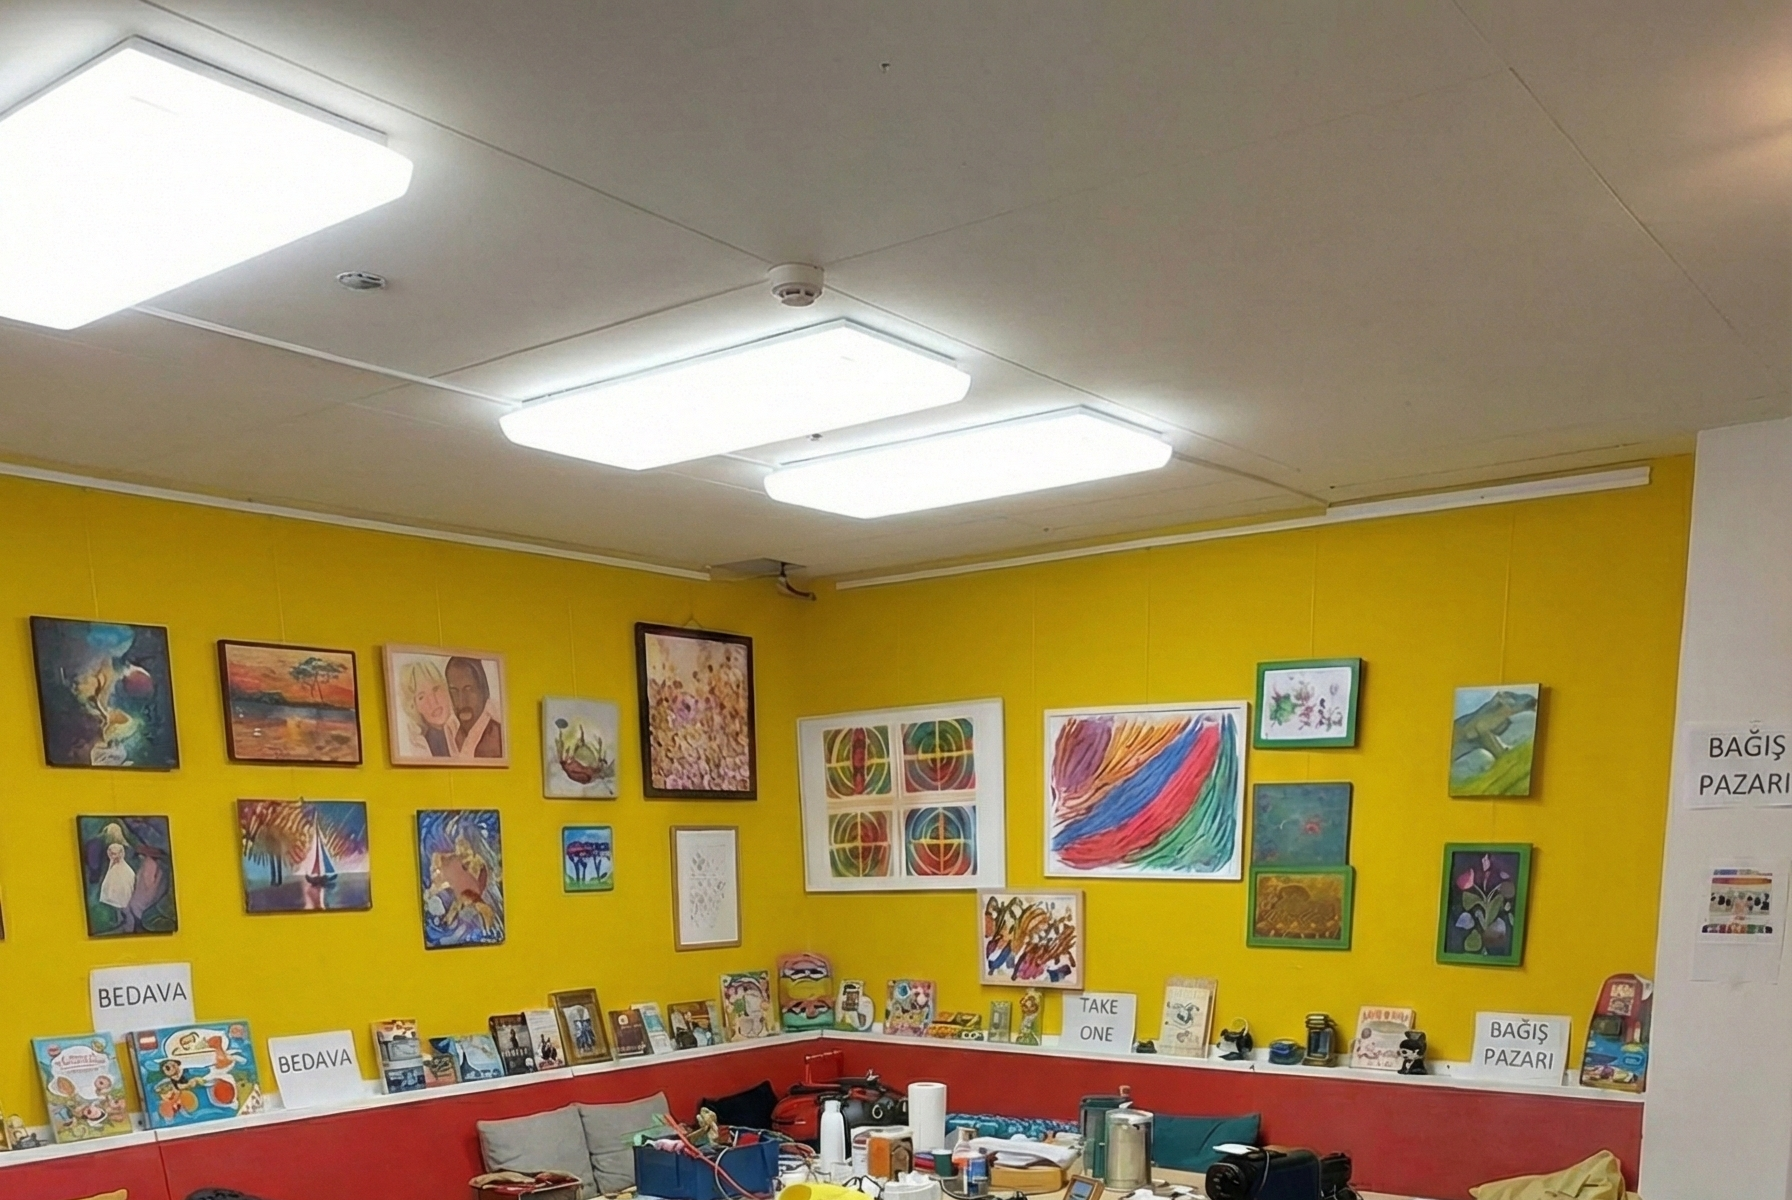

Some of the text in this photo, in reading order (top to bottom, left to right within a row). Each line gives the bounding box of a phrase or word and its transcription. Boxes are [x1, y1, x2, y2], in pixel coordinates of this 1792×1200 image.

[1708, 728, 1786, 761] BAĞIŞ
[1698, 772, 1791, 796] PAZARI
[98, 981, 187, 1009] BEDAVA
[1080, 997, 1118, 1015] TAKE
[1080, 1026, 1114, 1042] ONE
[1489, 1017, 1549, 1044] BAĞIŞ
[277, 1047, 353, 1074] BEDAVA
[1483, 1047, 1555, 1070] PAZARI
